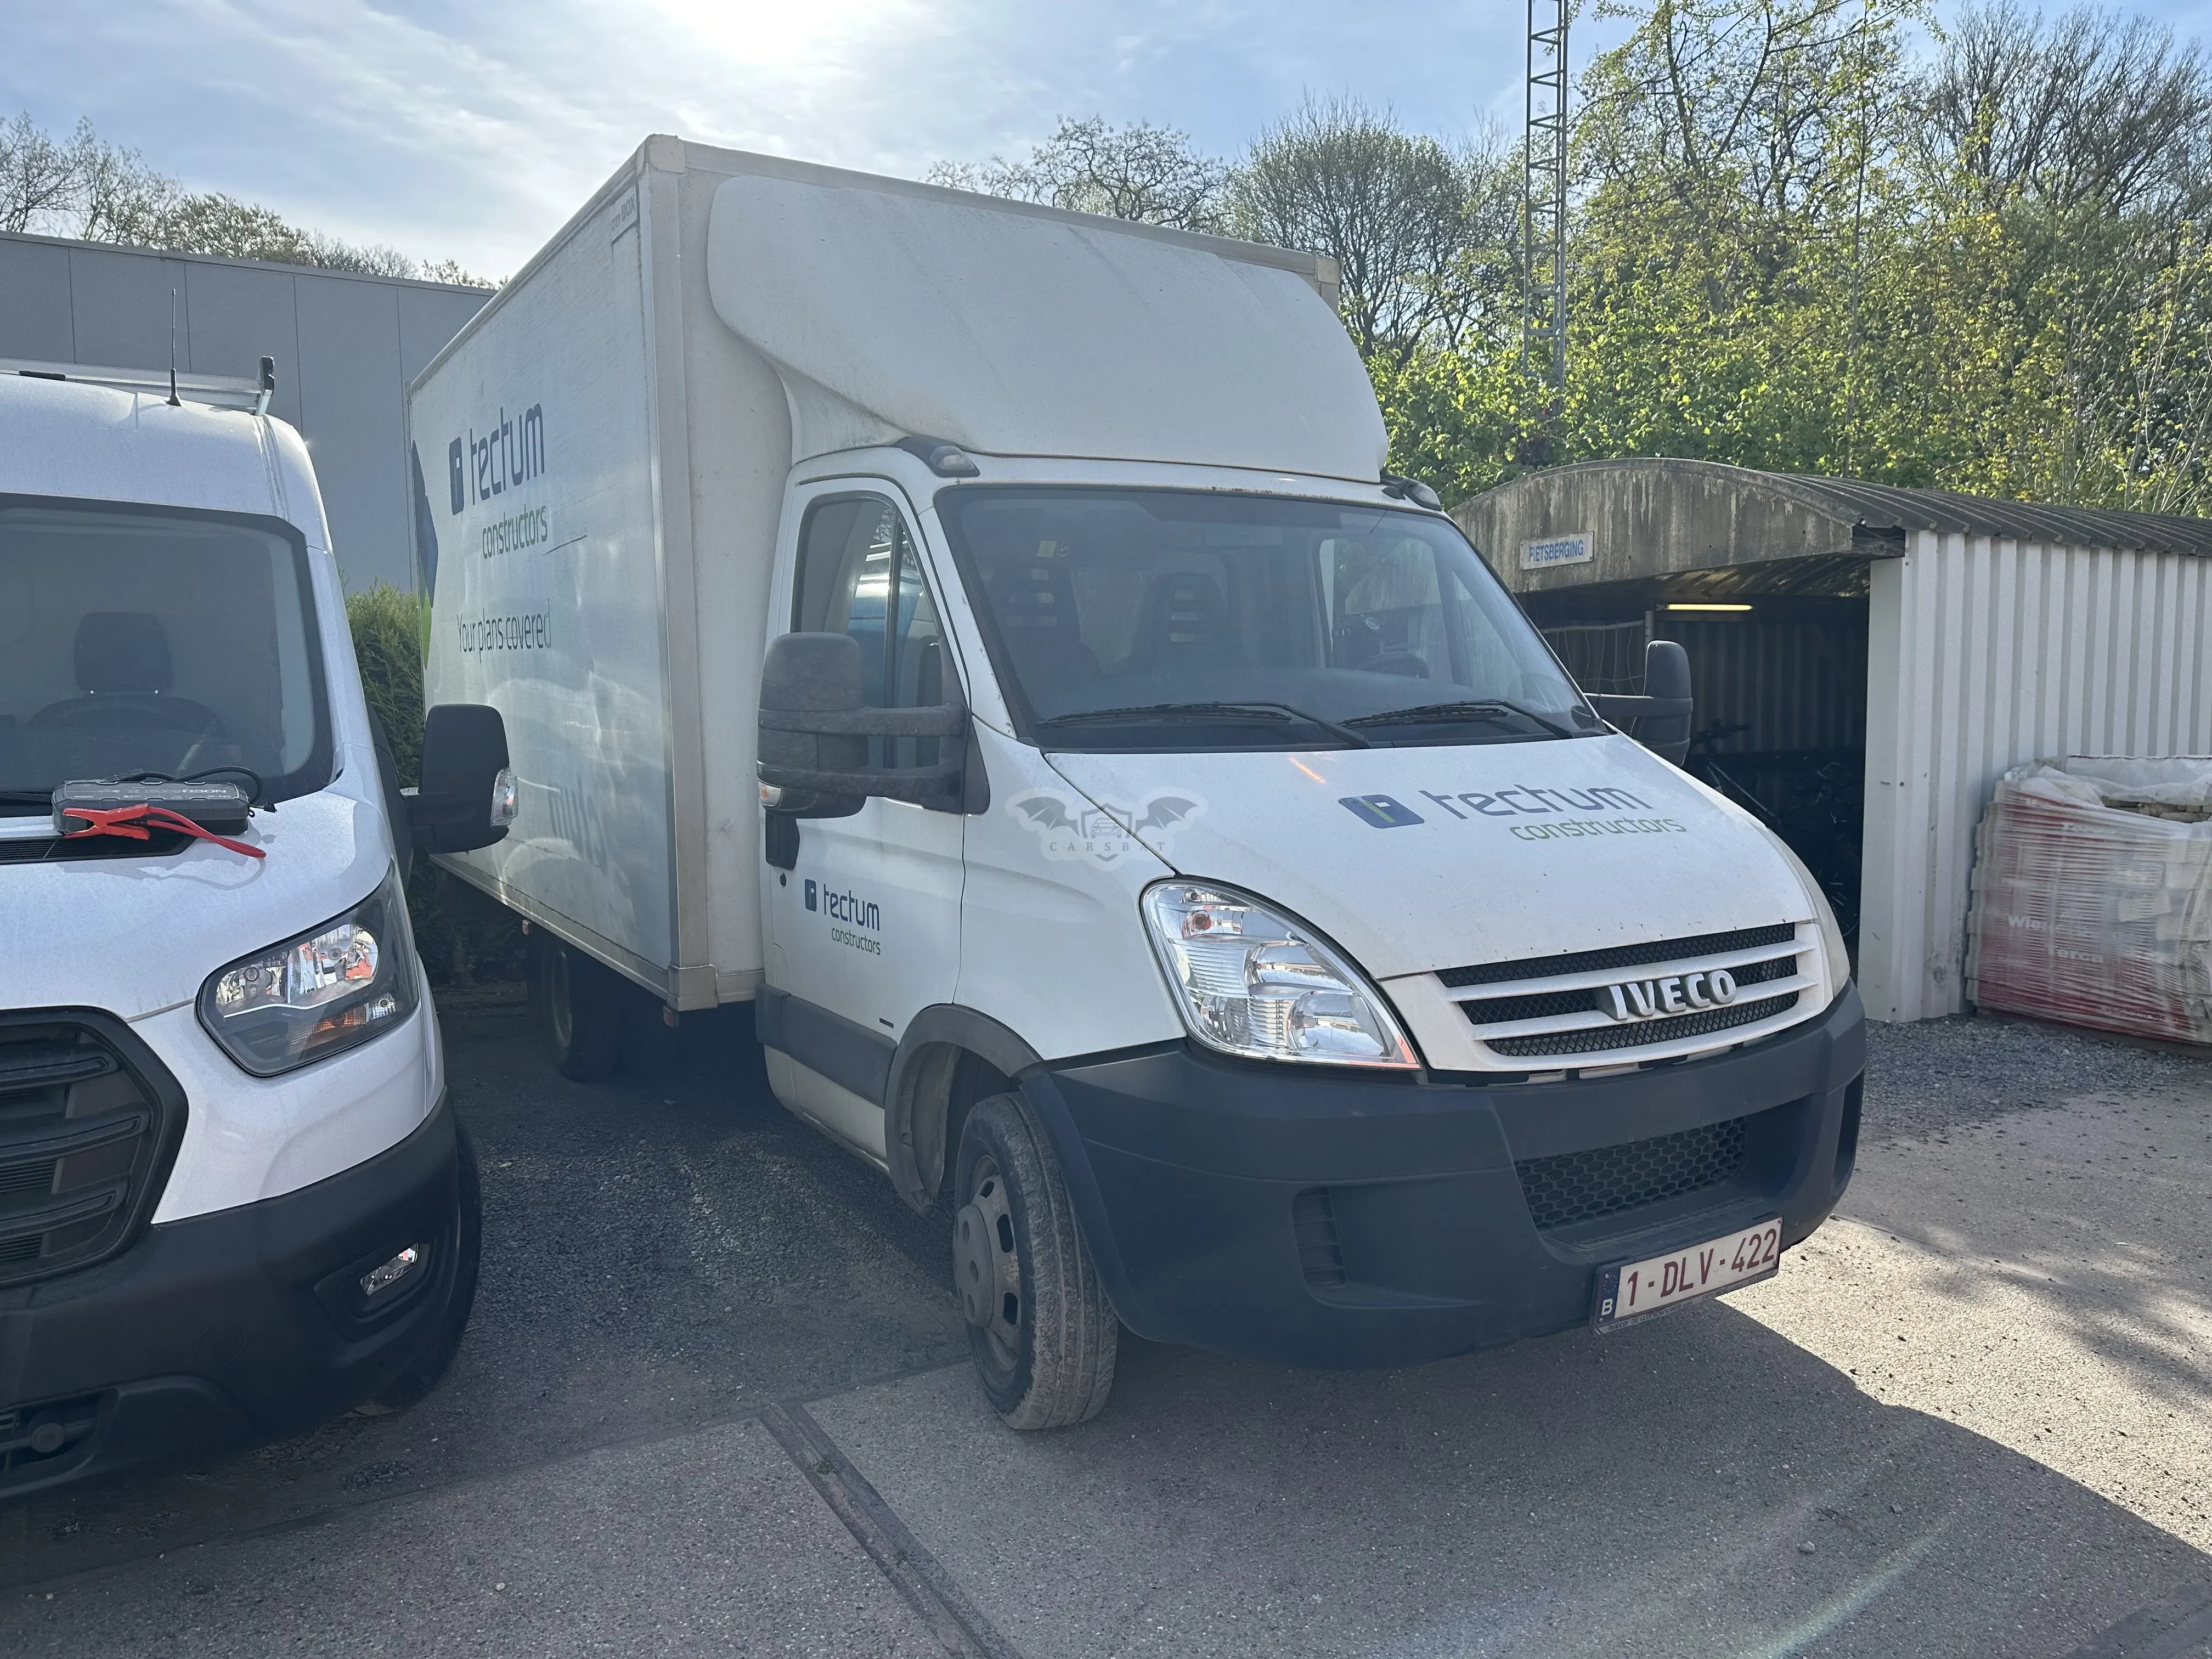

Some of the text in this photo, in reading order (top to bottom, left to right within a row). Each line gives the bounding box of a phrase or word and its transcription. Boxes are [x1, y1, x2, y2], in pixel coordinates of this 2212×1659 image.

[470, 403, 545, 505] tectum
[482, 504, 547, 559] constructors
[1529, 540, 1583, 562] FIETSBERGING
[457, 597, 552, 663] Your plans covered
[1419, 784, 1654, 819] tectum
[1510, 817, 1687, 840] constructors
[823, 883, 880, 931] tectum
[832, 927, 881, 956] constructors
[1599, 969, 1736, 1020] IVECO
[1628, 1228, 1777, 1306] 1-DLV-422
[1601, 1298, 1613, 1316] B
[1609, 1321, 1628, 1330] IVECO
